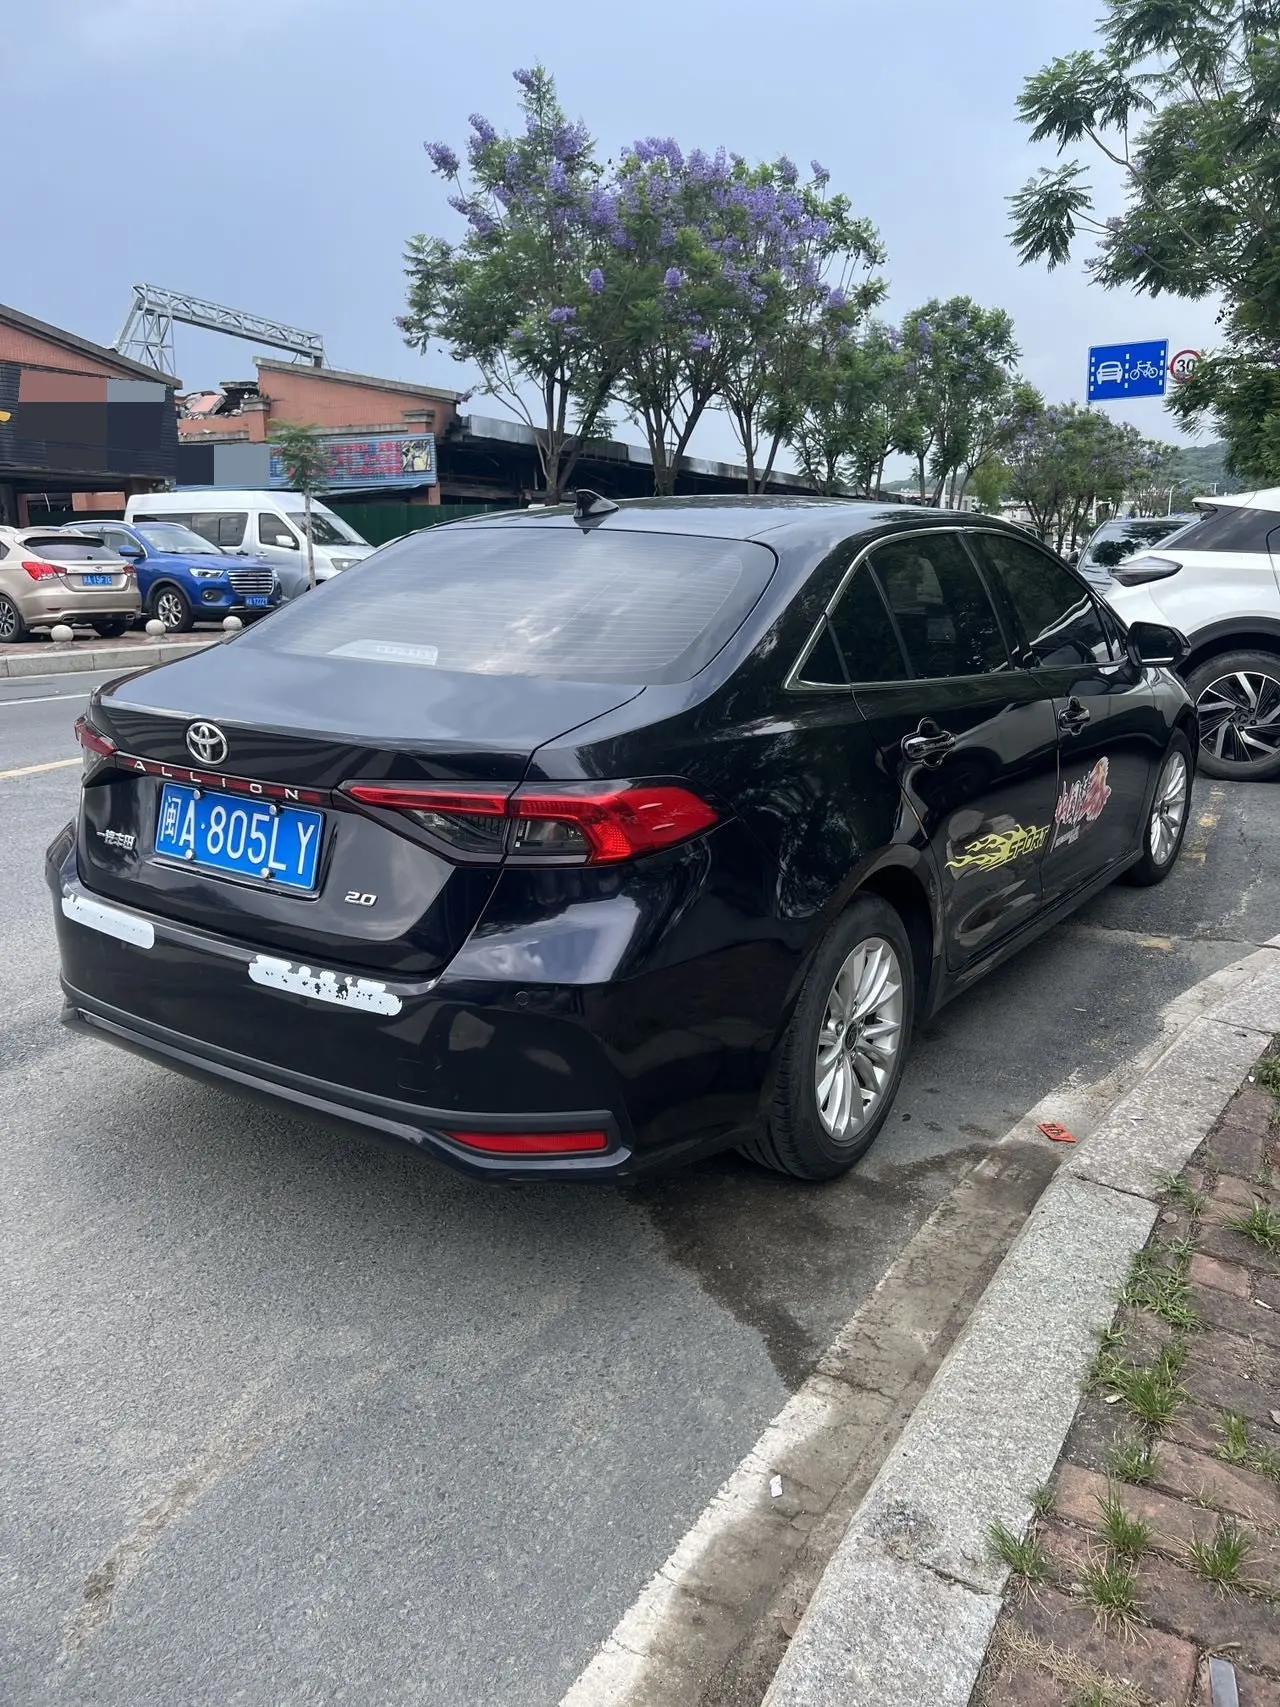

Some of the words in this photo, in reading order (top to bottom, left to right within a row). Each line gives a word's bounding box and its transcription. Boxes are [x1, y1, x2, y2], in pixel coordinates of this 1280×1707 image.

[1177, 359, 1195, 373] 30
[133, 760, 299, 800] ALLION
[1006, 826, 1050, 859] SPORT
